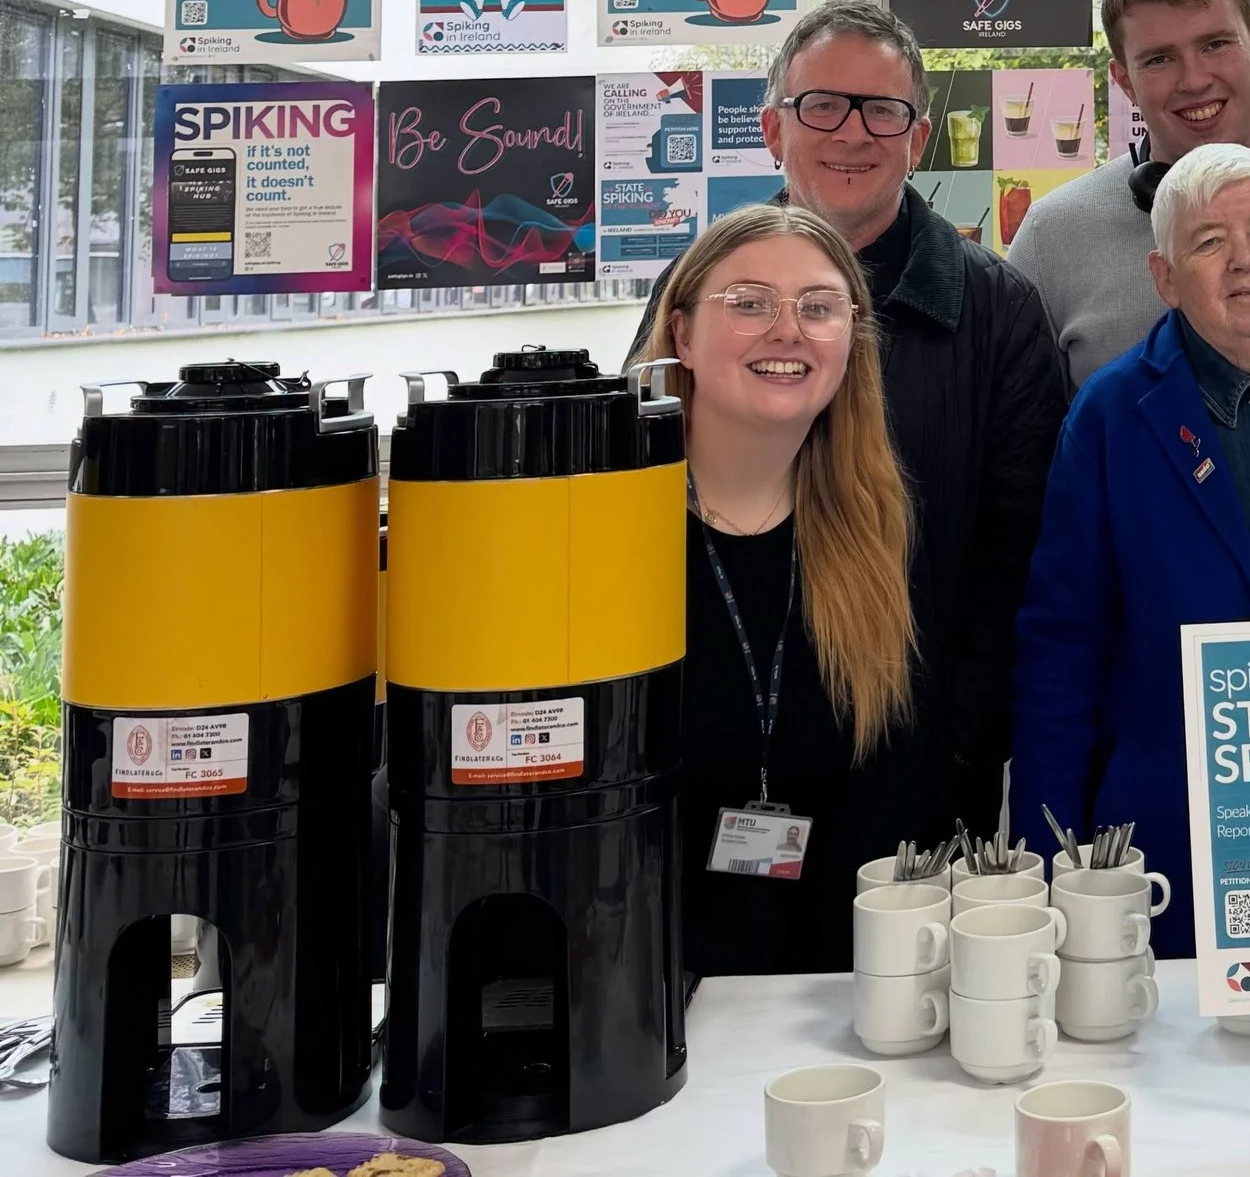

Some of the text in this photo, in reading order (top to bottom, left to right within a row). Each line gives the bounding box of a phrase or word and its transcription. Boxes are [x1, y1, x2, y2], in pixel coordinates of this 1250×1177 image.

[446, 22, 490, 31] Spiking
[963, 21, 1021, 31] SAFE GIGS
[446, 32, 500, 42] in Ireland
[604, 89, 647, 97] CALLING
[175, 103, 355, 141] SPIKING
[389, 106, 447, 169] Be
[457, 97, 583, 175] Sound!
[248, 145, 310, 157] if it's not
[247, 158, 309, 171] counted,
[247, 176, 314, 188] it doesn't
[615, 183, 644, 192] STATE
[246, 190, 291, 201] count.
[603, 193, 654, 204] SPIKING
[541, 754, 561, 762] 3064
[186, 769, 223, 779] FC 3065
